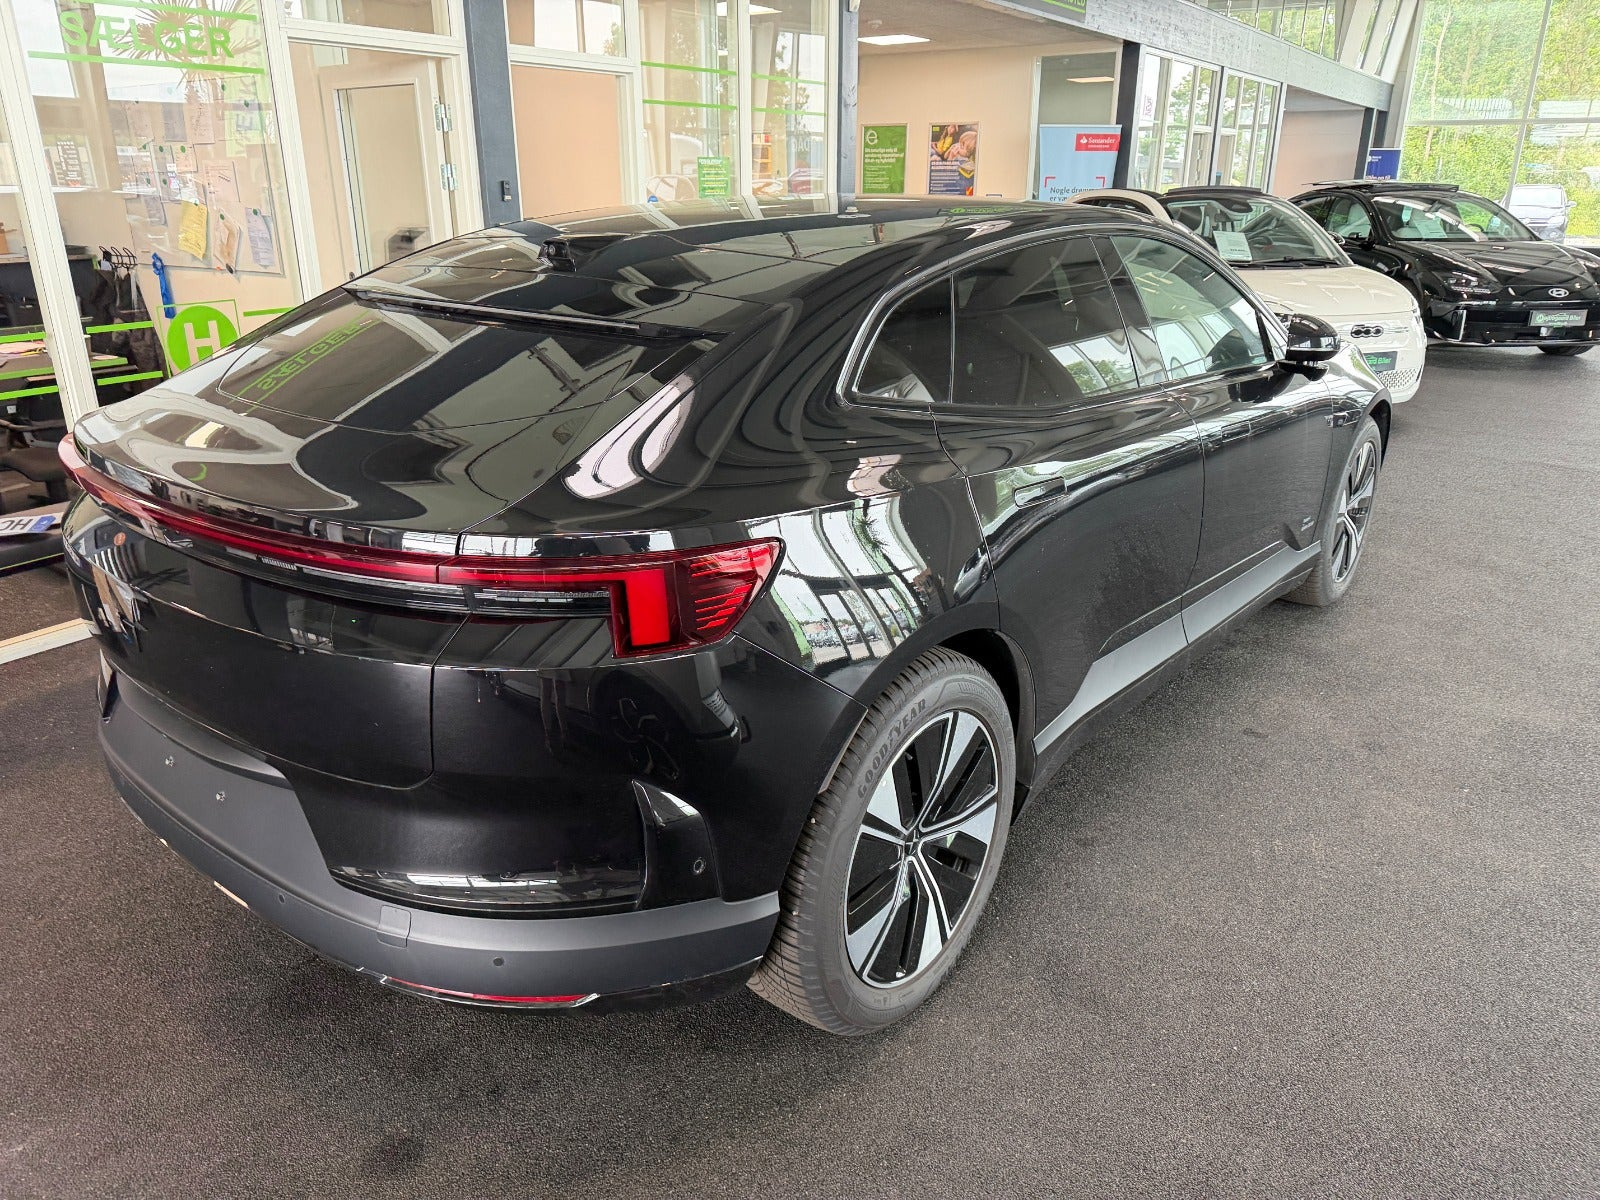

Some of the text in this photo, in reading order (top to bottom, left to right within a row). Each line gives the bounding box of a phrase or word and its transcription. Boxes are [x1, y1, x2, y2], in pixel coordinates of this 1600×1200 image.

[59, 11, 234, 58] SÆLGER
[1088, 136, 1115, 144] Santander
[1050, 187, 1070, 195] Nogle
[857, 698, 927, 799] GOODYEAR
